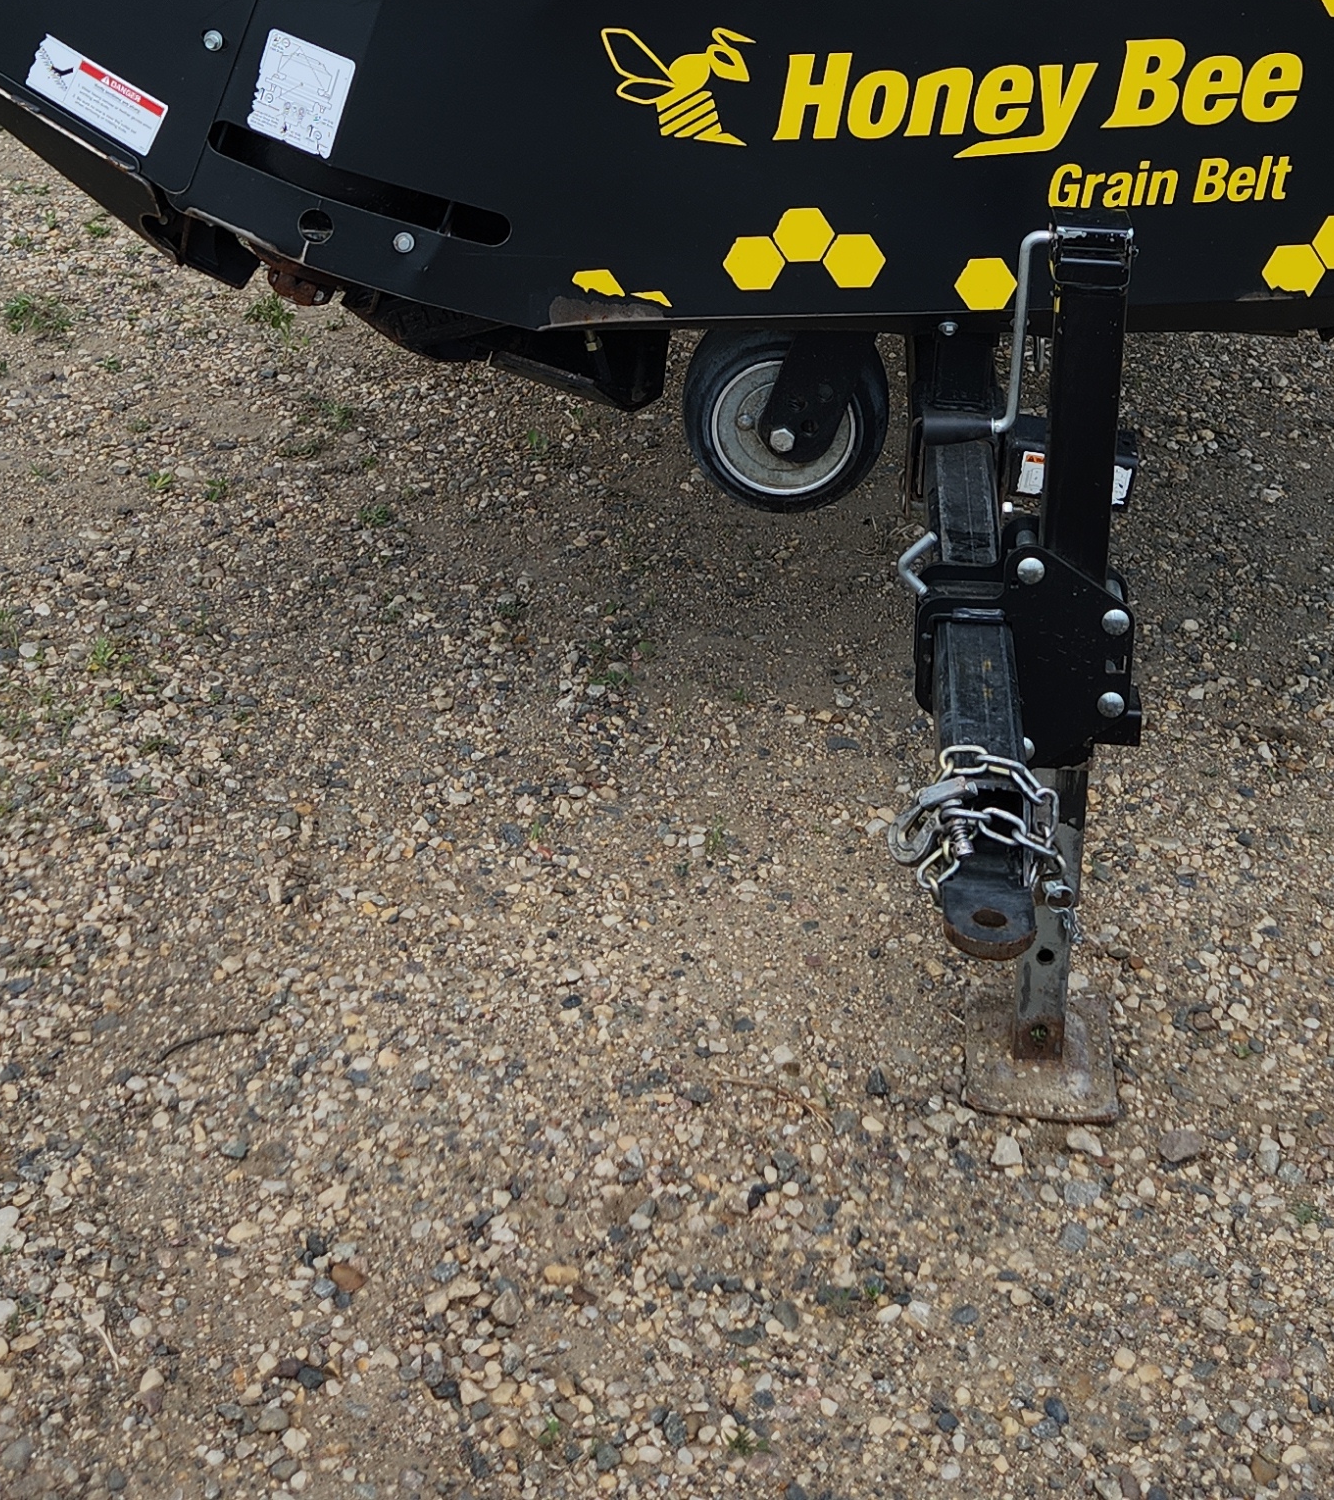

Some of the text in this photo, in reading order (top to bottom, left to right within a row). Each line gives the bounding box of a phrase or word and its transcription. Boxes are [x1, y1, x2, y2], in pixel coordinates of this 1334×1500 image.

[110, 81, 142, 103] DANGER
[773, 39, 1303, 158] Honey Bee
[1047, 156, 1292, 209] Grain Belt
